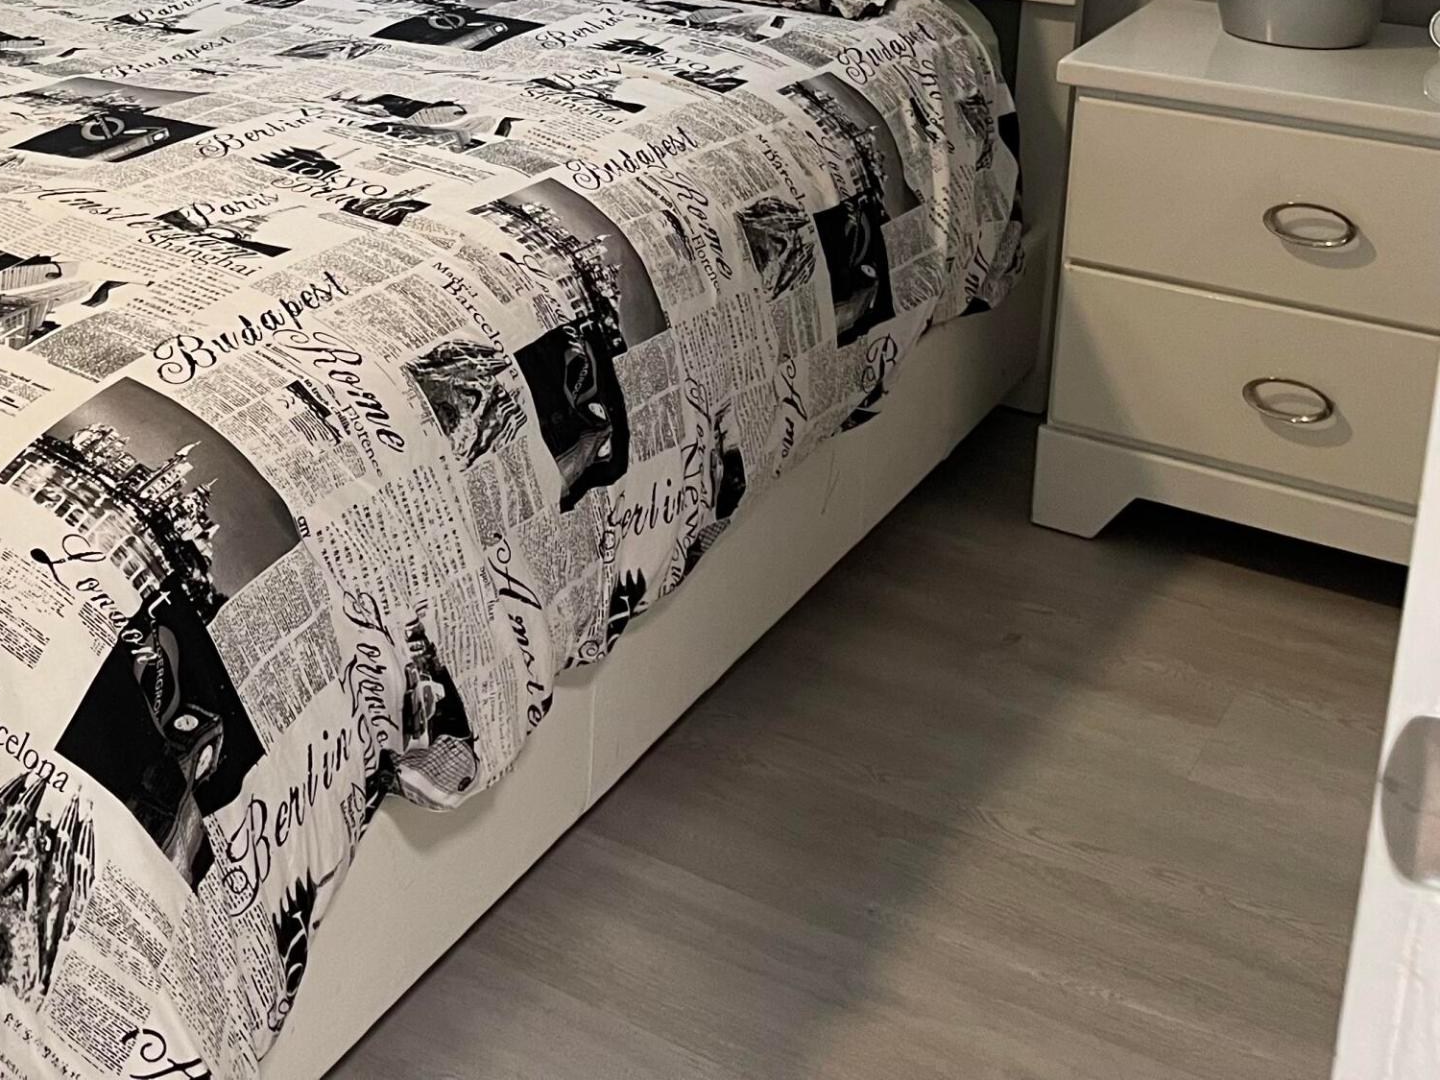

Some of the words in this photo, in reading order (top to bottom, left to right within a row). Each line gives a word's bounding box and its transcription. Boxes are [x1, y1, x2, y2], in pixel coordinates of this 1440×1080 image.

[101, 35, 236, 79] Budapest
[196, 114, 308, 158] Berlin
[565, 126, 698, 190] Budapest
[179, 190, 280, 231] Paris
[284, 156, 388, 197] Tokyo
[14, 184, 261, 259] Amsterdam
[137, 229, 263, 278] Shanghai
[152, 270, 350, 385] Budapest
[272, 328, 406, 454] Rome
[342, 404, 385, 479] Florence
[296, 514, 312, 539] CITY
[29, 533, 159, 666] London
[343, 590, 400, 748] Toronto
[221, 727, 353, 918] Berlin
